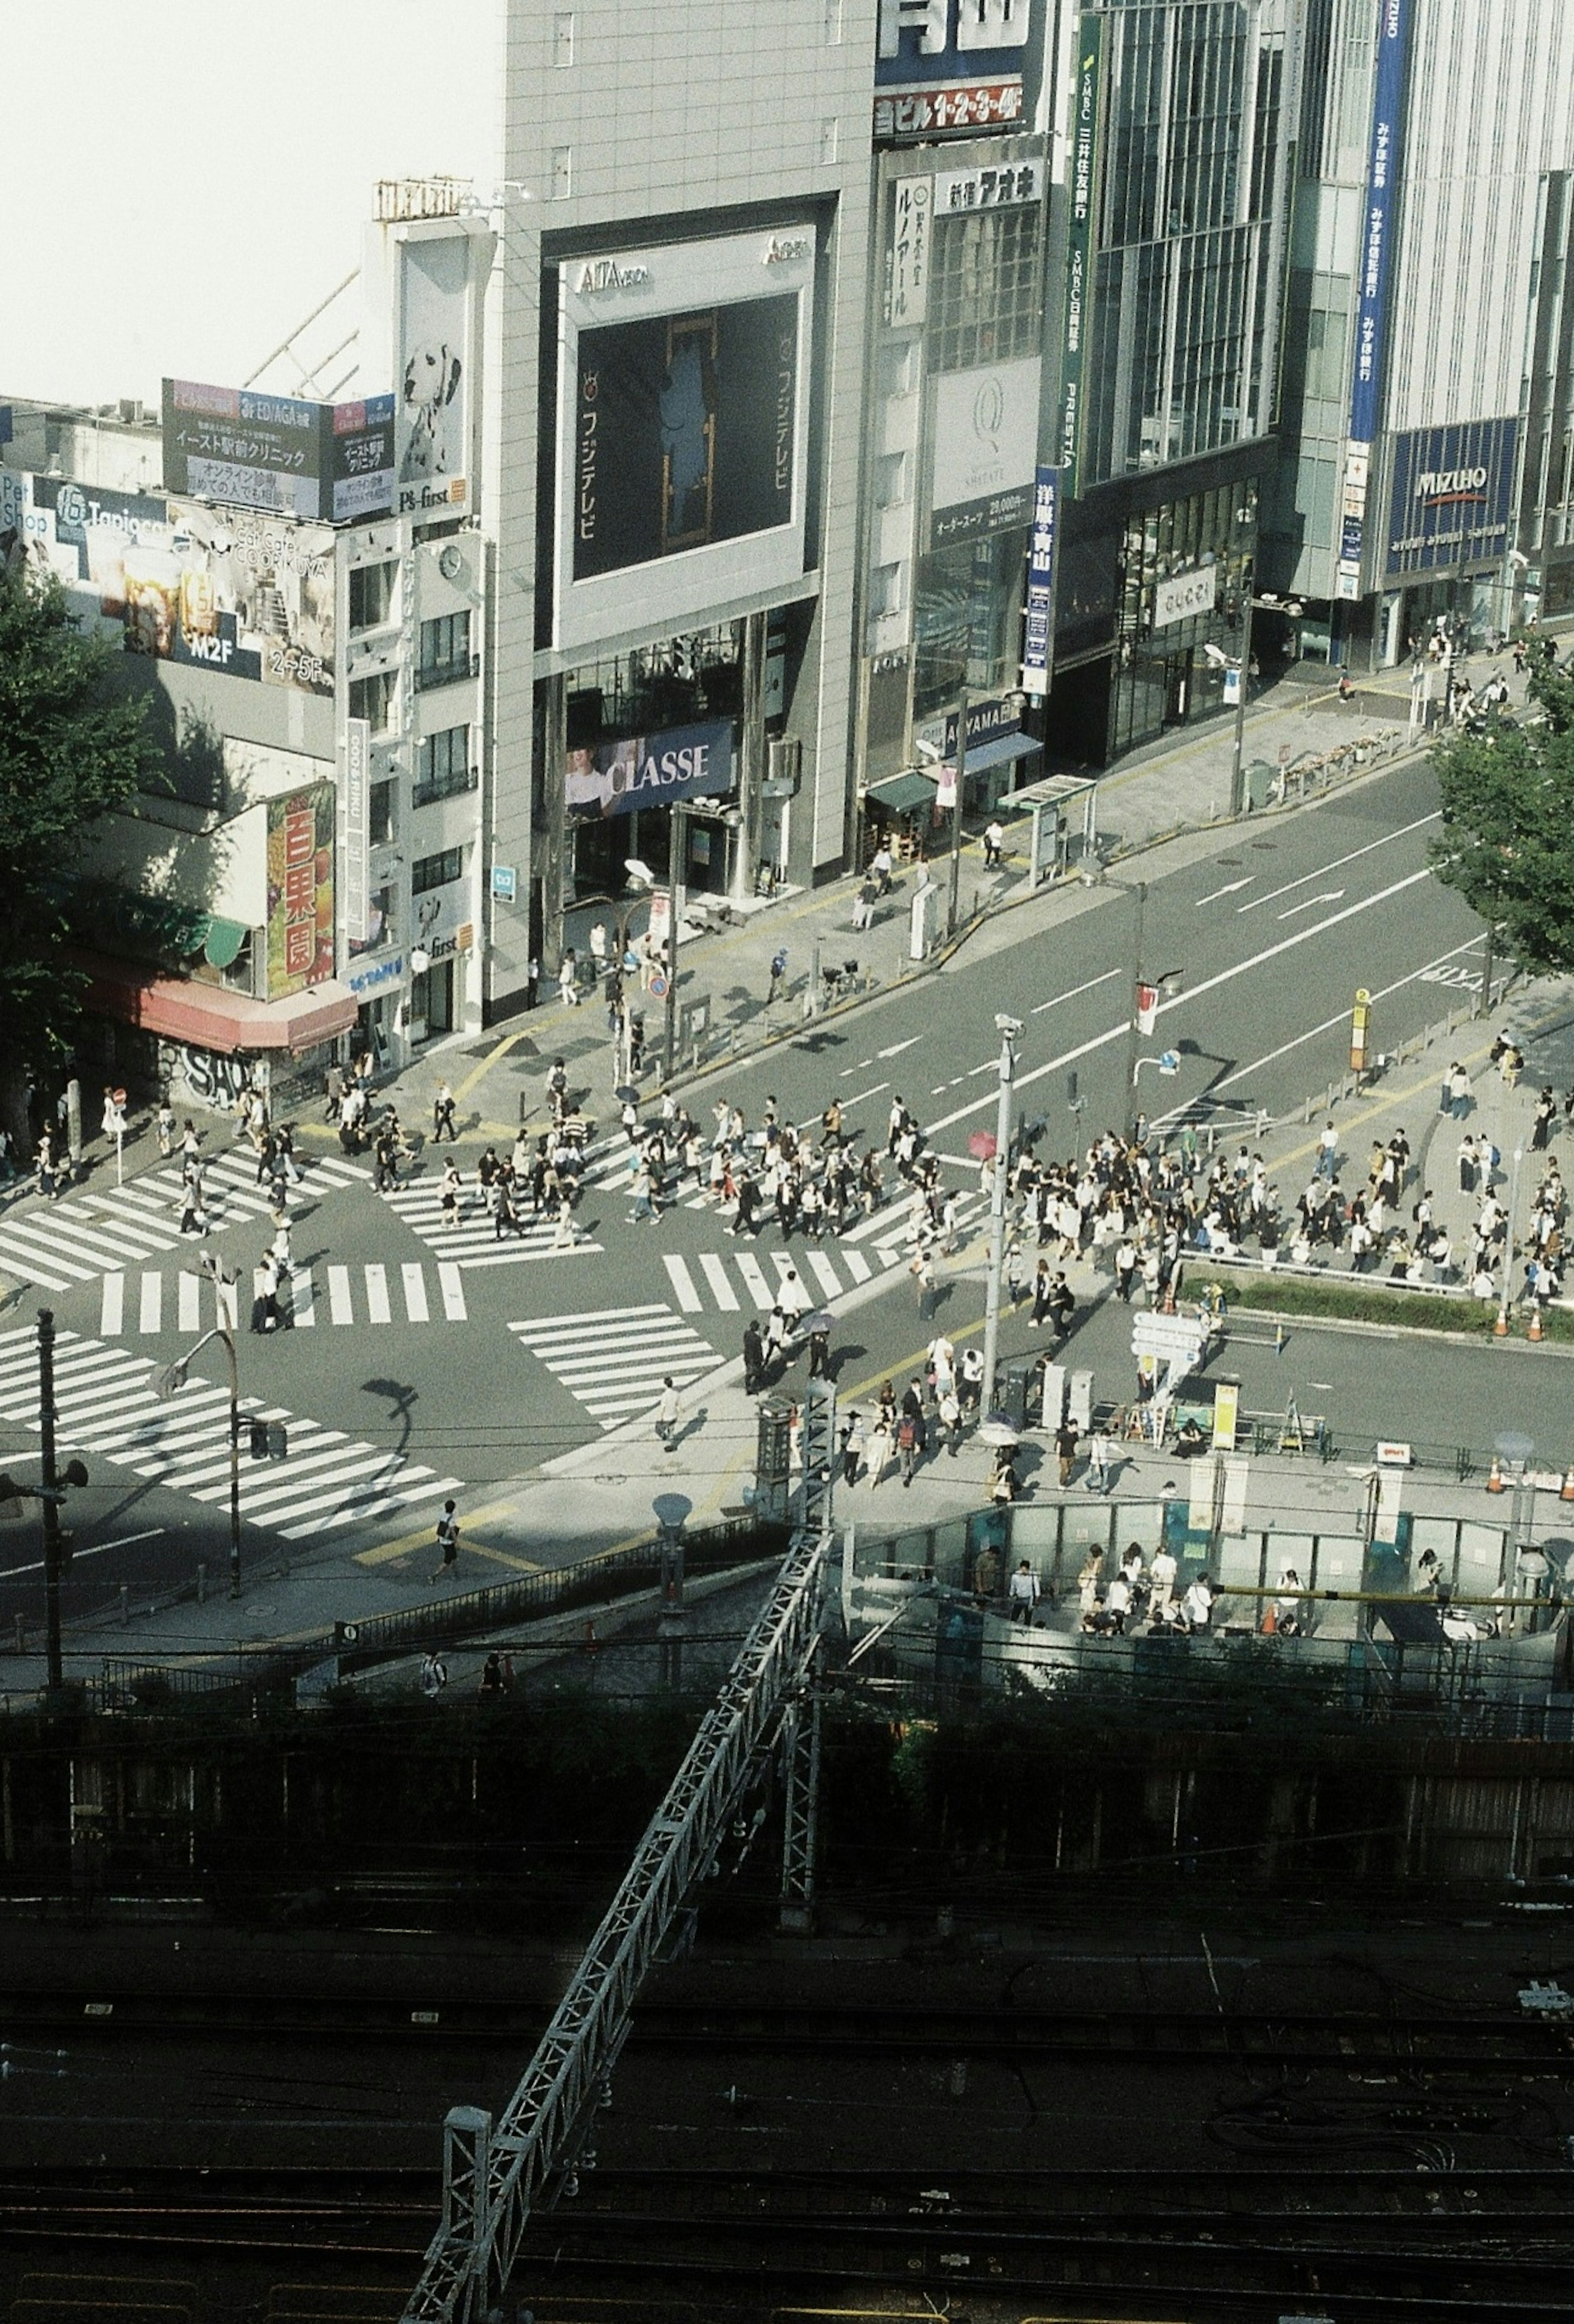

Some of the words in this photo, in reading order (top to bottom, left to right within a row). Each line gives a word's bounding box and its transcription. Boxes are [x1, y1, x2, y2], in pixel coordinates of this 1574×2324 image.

[1080, 74, 1092, 121] SMBC
[894, 188, 912, 316] ルノアール
[176, 429, 306, 467] イースト駅前クリニック
[775, 370, 791, 491] フジテレビ
[2, 475, 29, 502] Pet
[580, 412, 598, 539] フジテレビ
[1415, 467, 1487, 497] MIZUHO
[4, 502, 48, 538] Shop
[1166, 582, 1208, 614] GUCCI
[191, 636, 232, 663] M2F
[946, 708, 999, 743] AYAMA
[606, 744, 710, 795] CLASSE
